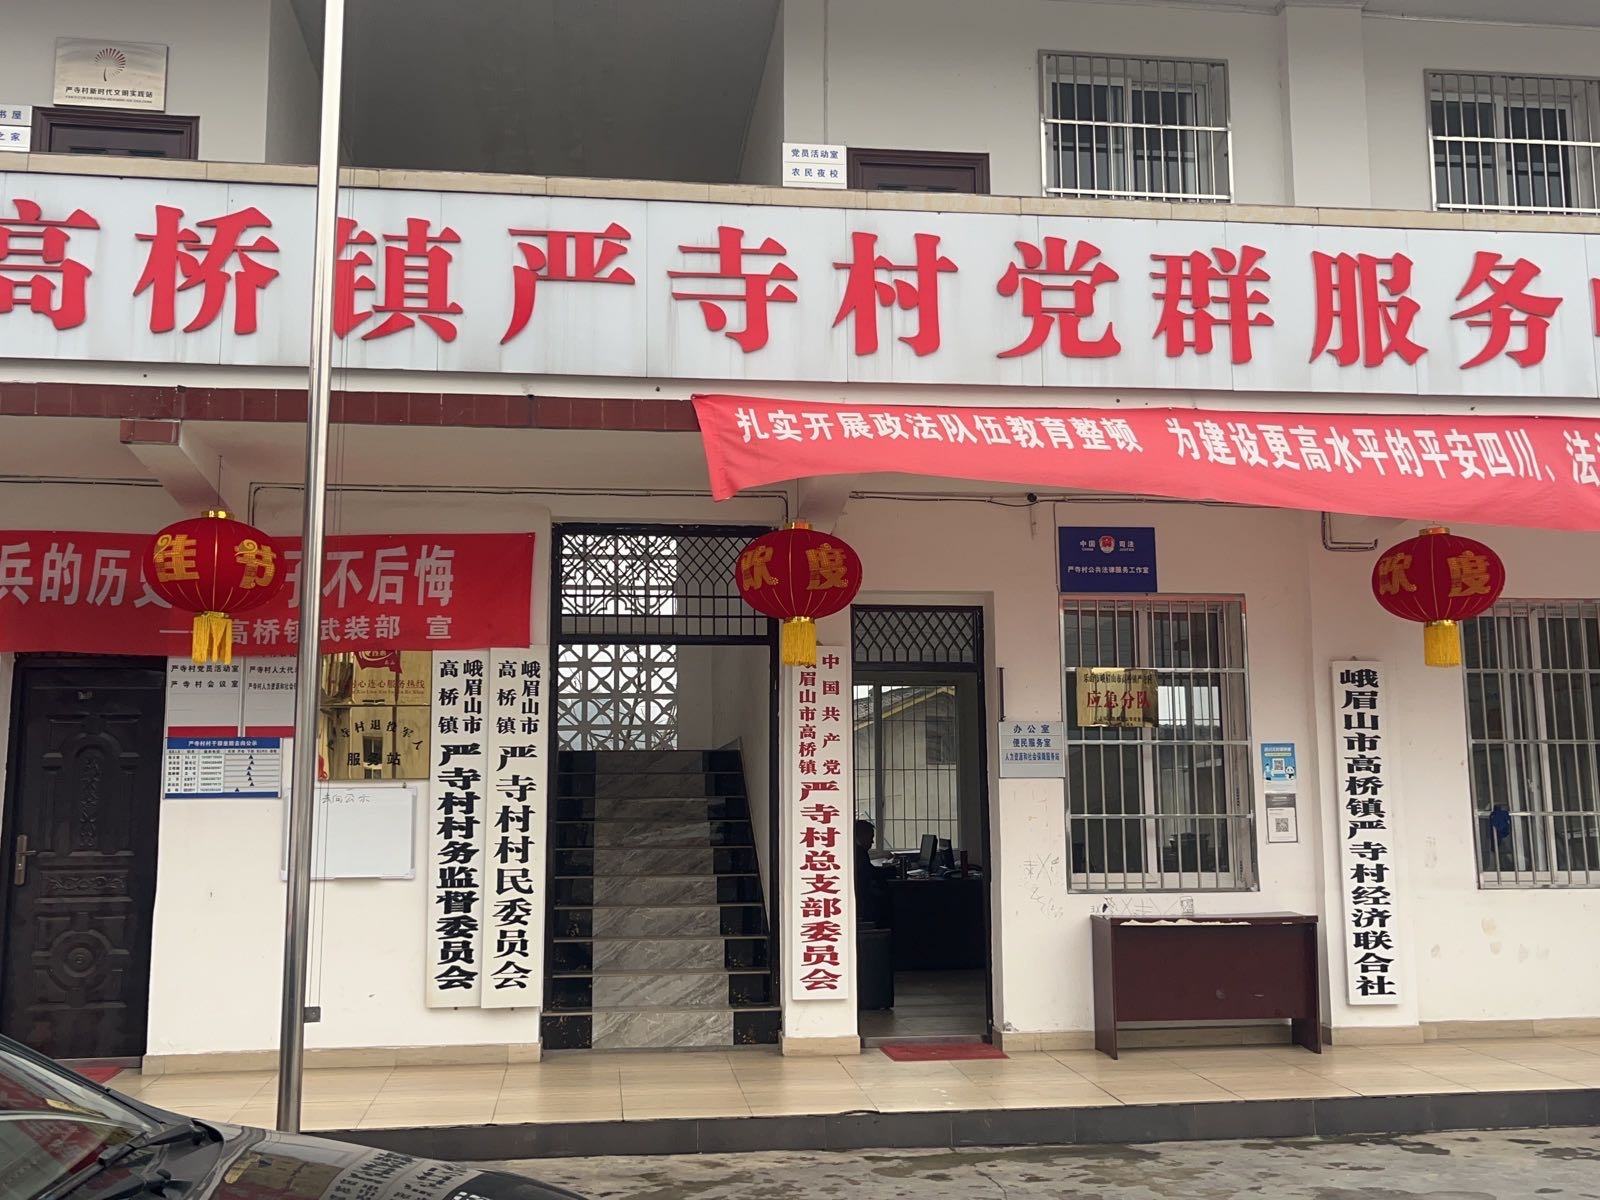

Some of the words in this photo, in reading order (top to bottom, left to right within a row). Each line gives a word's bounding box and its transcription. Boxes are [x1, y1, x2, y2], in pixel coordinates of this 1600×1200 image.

[65, 86, 153, 98] 严寺村新时代文明实践站
[791, 148, 839, 160] 党员活动室
[791, 167, 838, 178] 农民夜校
[0, 198, 1600, 370] 高桥镇严寺村党群服务
[734, 406, 1144, 454] 扎实开展政法队伍教育整顿
[1165, 418, 1600, 488] 为建设更高水平的平安四川、法
[426, 615, 452, 640] 宣
[170, 680, 239, 688] 严寺村会议室
[171, 664, 240, 673] 严寺村党员活动室
[249, 665, 297, 674] 严寺村人大代
[438, 659, 459, 735] 高桥镇
[462, 659, 483, 735] 峨眉山市
[496, 660, 518, 735] 高桥镇
[519, 660, 541, 736] 峨眉山市
[1087, 690, 1151, 709] 应急分队
[822, 653, 841, 776] 中国共产党
[1013, 724, 1051, 734] 办公室
[347, 752, 401, 766] 服务站
[434, 742, 482, 991] 严寺村村务监督委员会
[490, 743, 537, 990] 严寺村村民委员会
[1340, 668, 1396, 997] 峨眉山市高桥镇严寺村经济联合社
[799, 780, 842, 992] 严寺村总支部委员会
